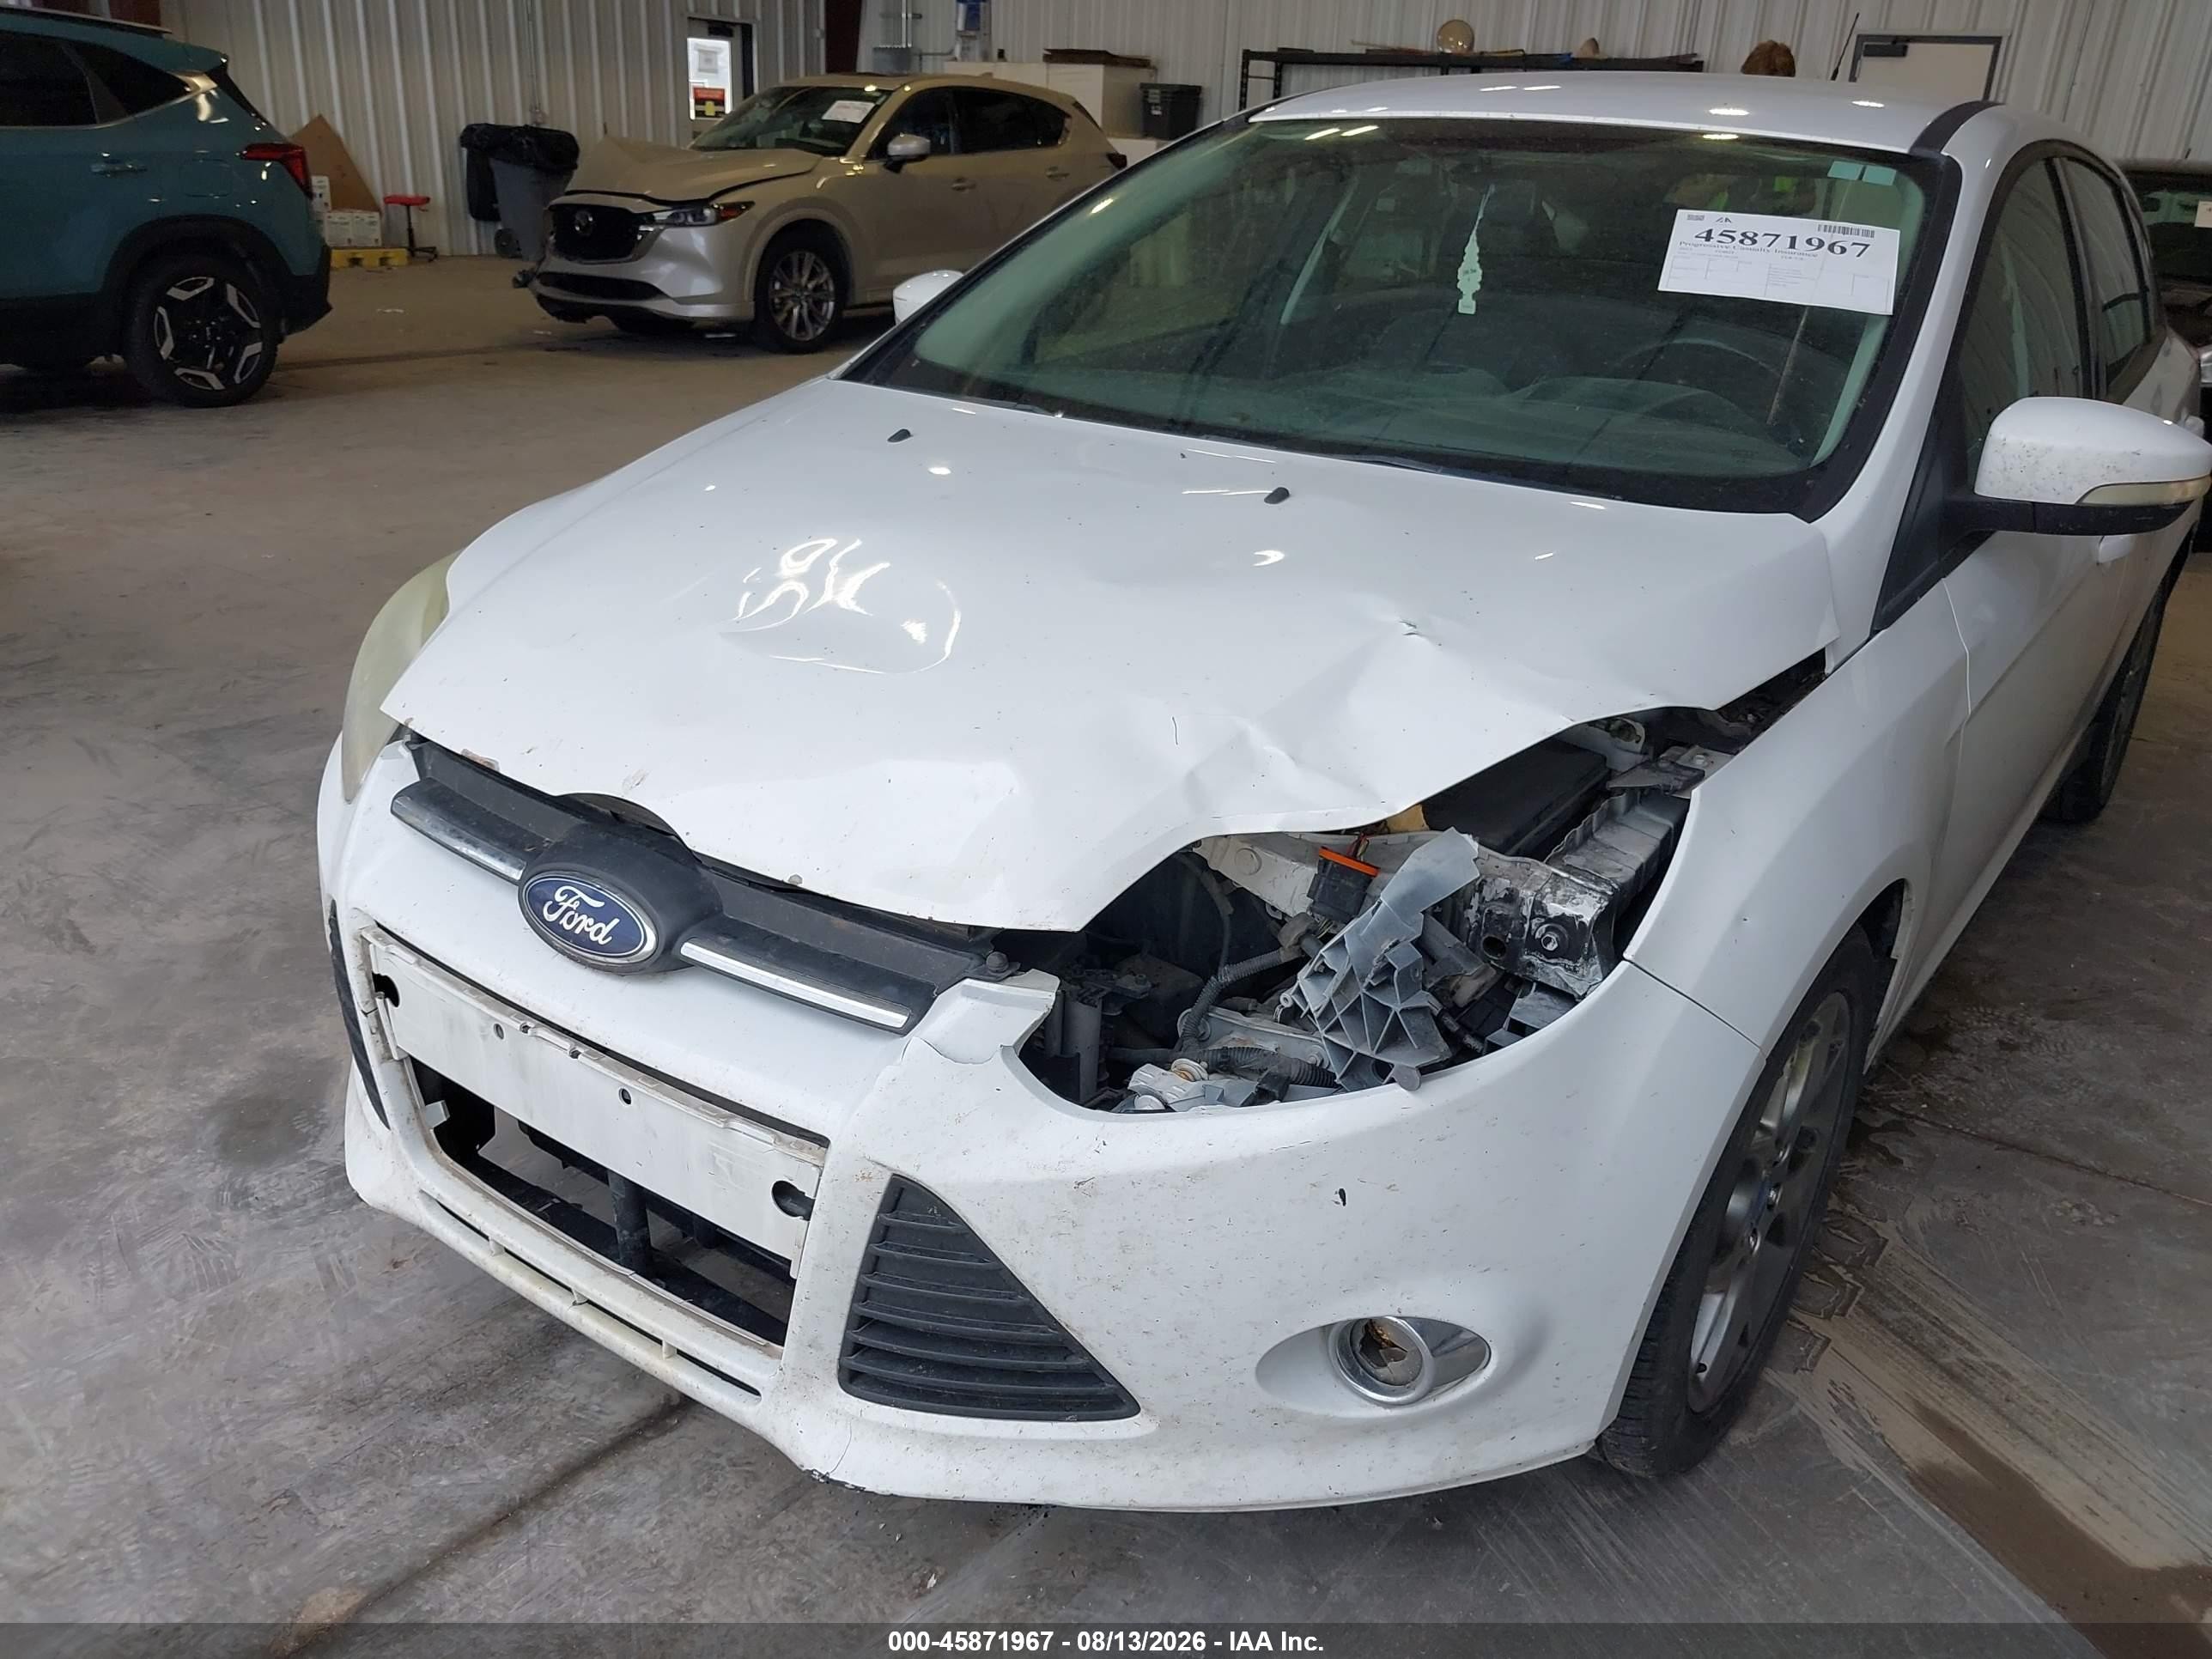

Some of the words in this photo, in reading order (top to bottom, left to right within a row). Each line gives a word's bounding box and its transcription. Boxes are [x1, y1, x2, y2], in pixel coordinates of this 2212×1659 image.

[1679, 241, 1730, 250] Progressive
[1694, 228, 1871, 258] 45871967
[543, 885, 620, 945] Ford
